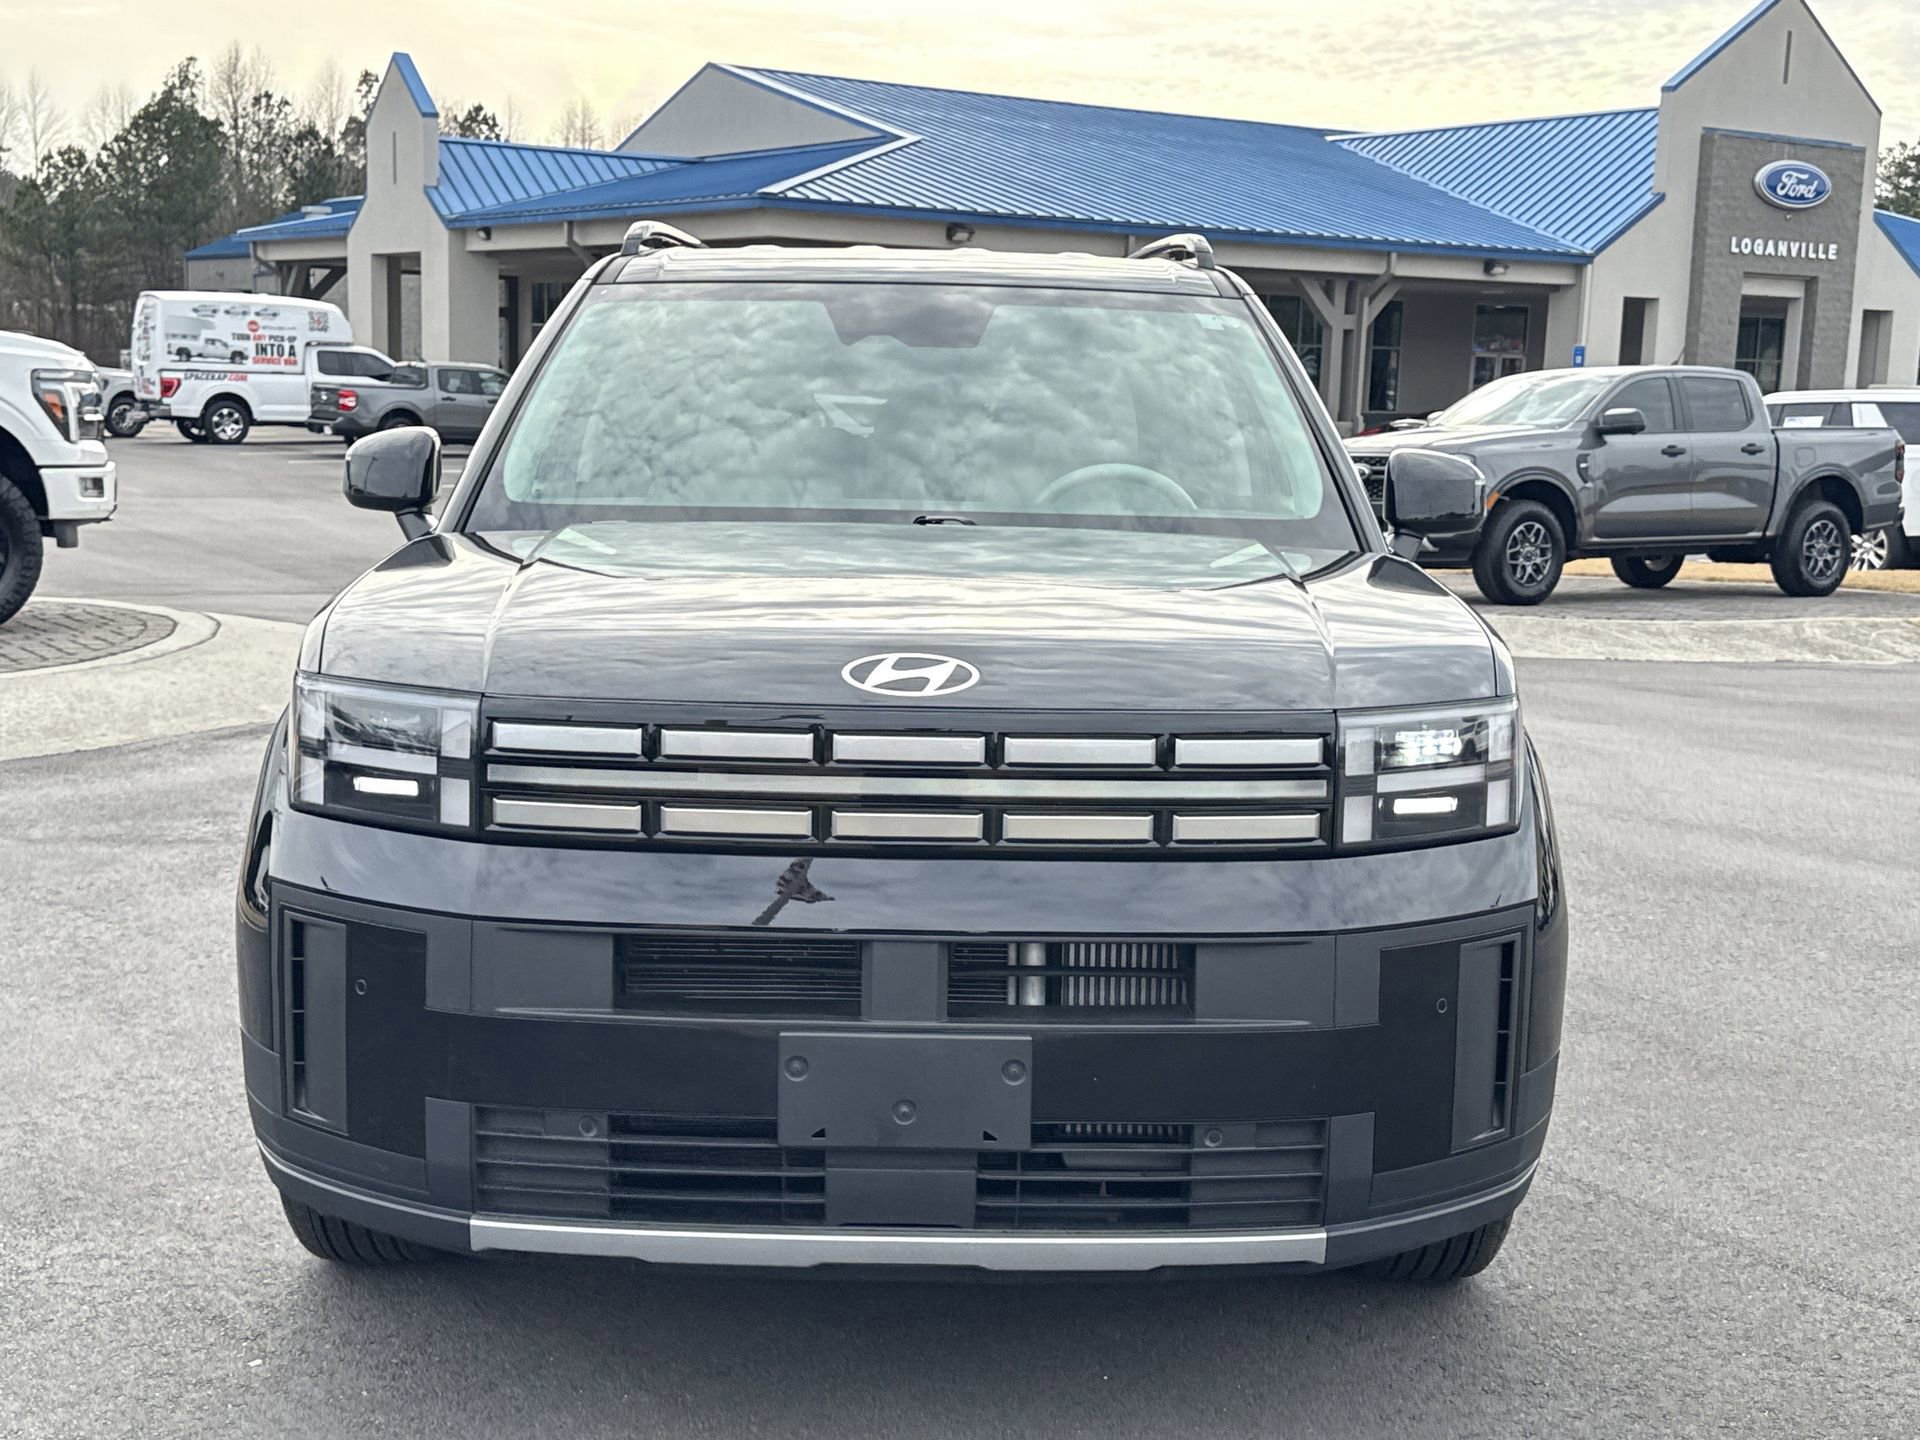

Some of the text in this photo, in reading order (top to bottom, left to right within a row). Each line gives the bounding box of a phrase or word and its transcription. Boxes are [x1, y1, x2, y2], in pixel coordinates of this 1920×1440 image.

[1776, 170, 1818, 199] Ford
[1730, 236, 1839, 260] LOGANVILLE
[255, 343, 297, 358] INTO A
[252, 356, 282, 365] SERVICE
